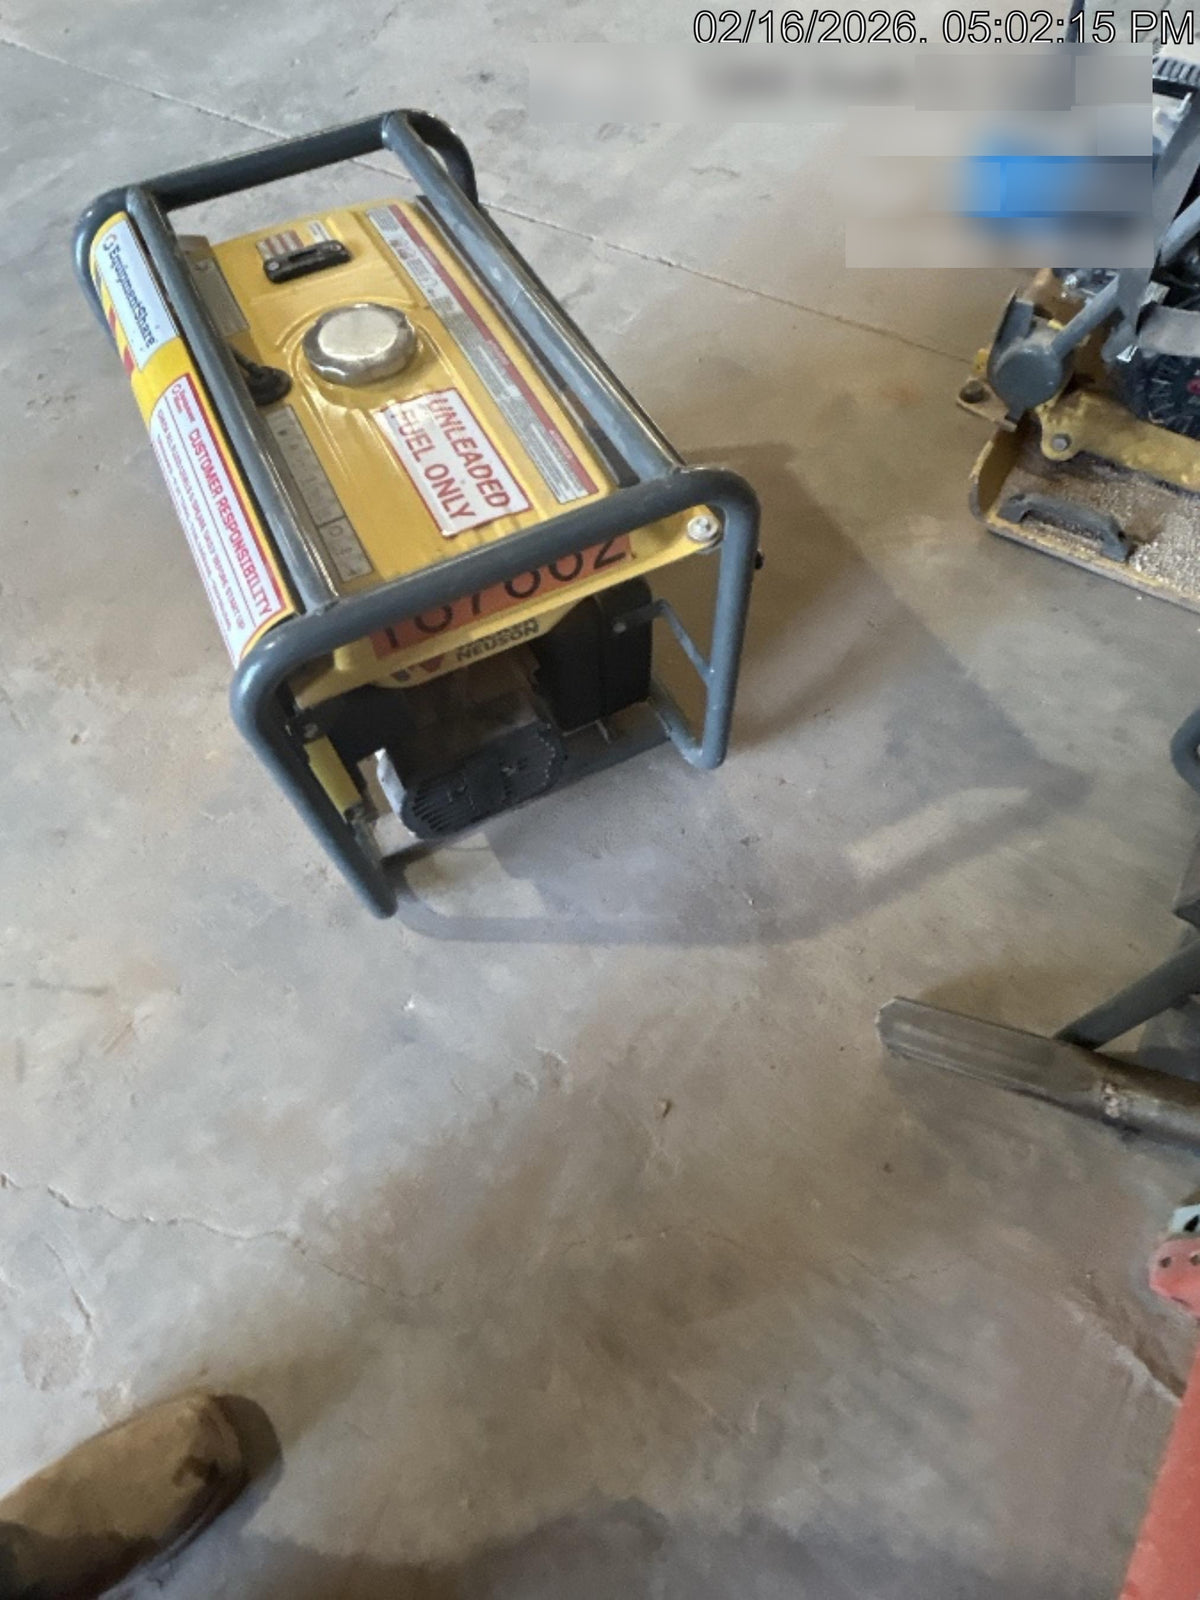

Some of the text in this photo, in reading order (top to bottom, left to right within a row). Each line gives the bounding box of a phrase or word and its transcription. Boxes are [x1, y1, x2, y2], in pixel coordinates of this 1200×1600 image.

[109, 246, 156, 348] EquipmentShare
[424, 463, 476, 519] ONLY
[428, 398, 511, 508] UNLEADED
[188, 428, 223, 498] CUSTOMER
[216, 496, 272, 616] RESPONSIBILITY
